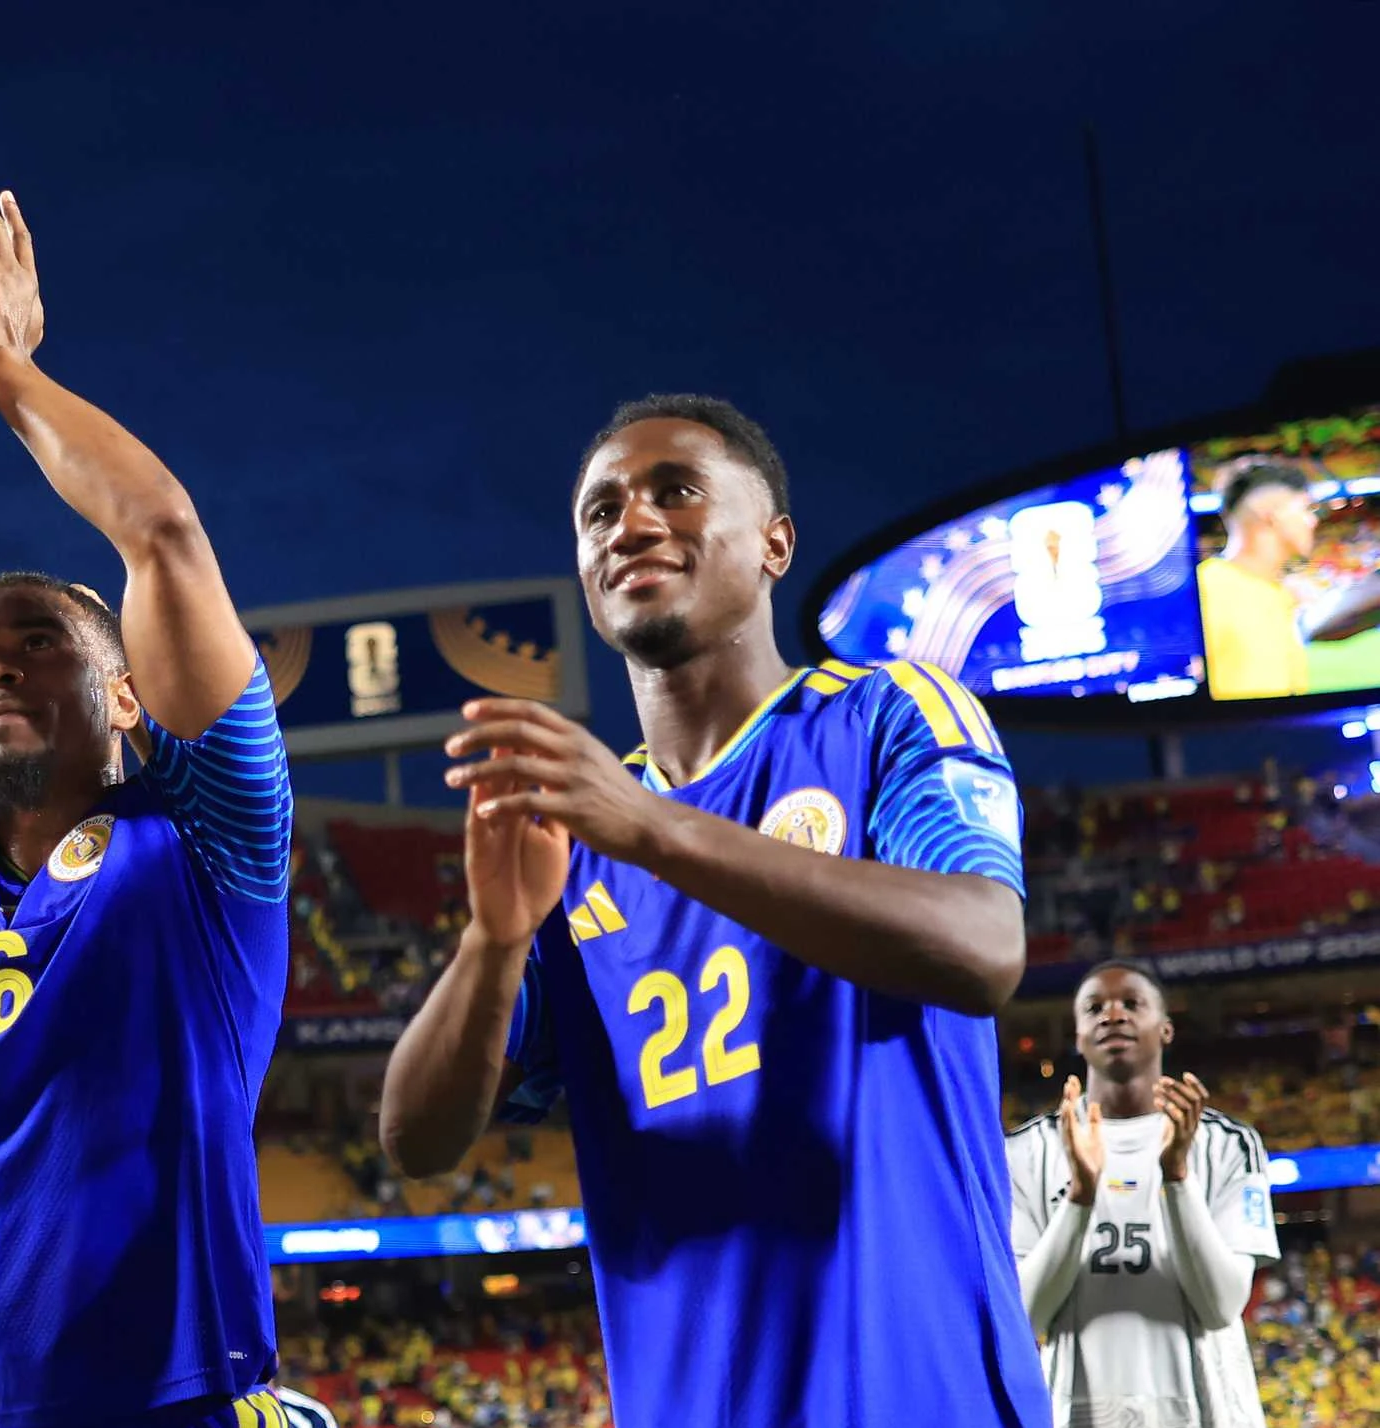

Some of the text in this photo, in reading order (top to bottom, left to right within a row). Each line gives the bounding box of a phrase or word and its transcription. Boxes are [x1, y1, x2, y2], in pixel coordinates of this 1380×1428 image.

[1316, 931, 1380, 961] 202
[626, 945, 761, 1110] 22
[1091, 1222, 1151, 1274] 25
